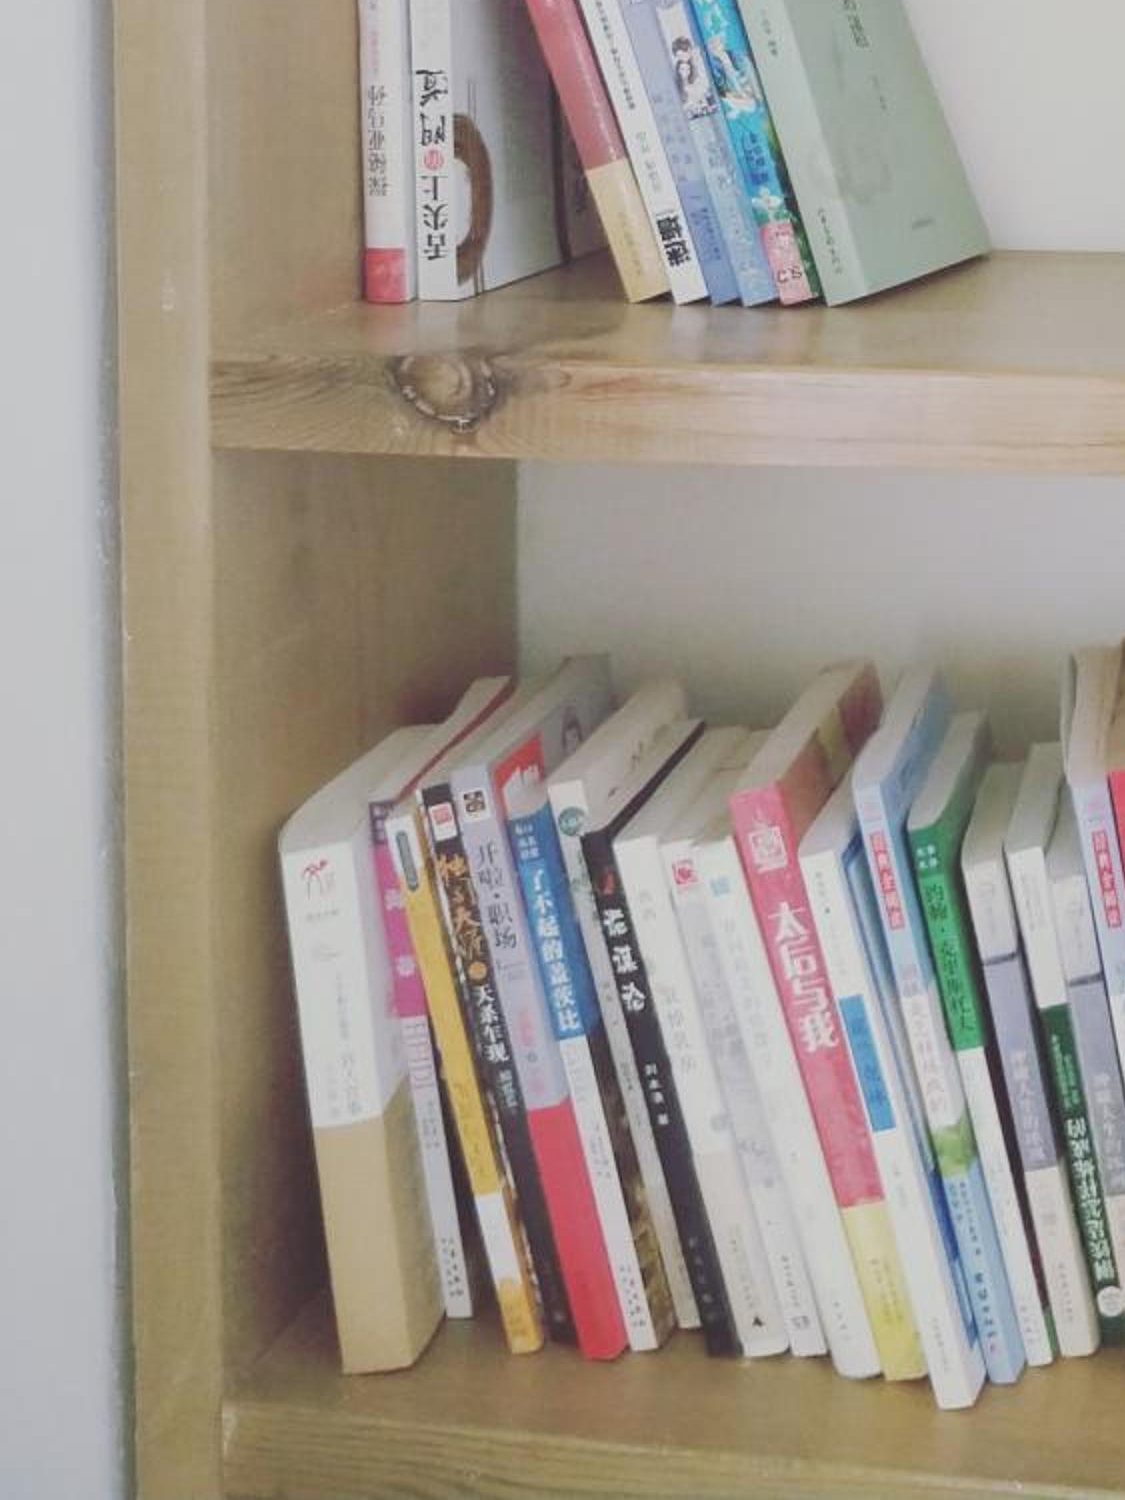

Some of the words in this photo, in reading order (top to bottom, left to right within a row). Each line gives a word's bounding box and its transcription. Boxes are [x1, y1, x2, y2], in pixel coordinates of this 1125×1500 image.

[530, 865, 584, 1033] 了不起的盖茨比
